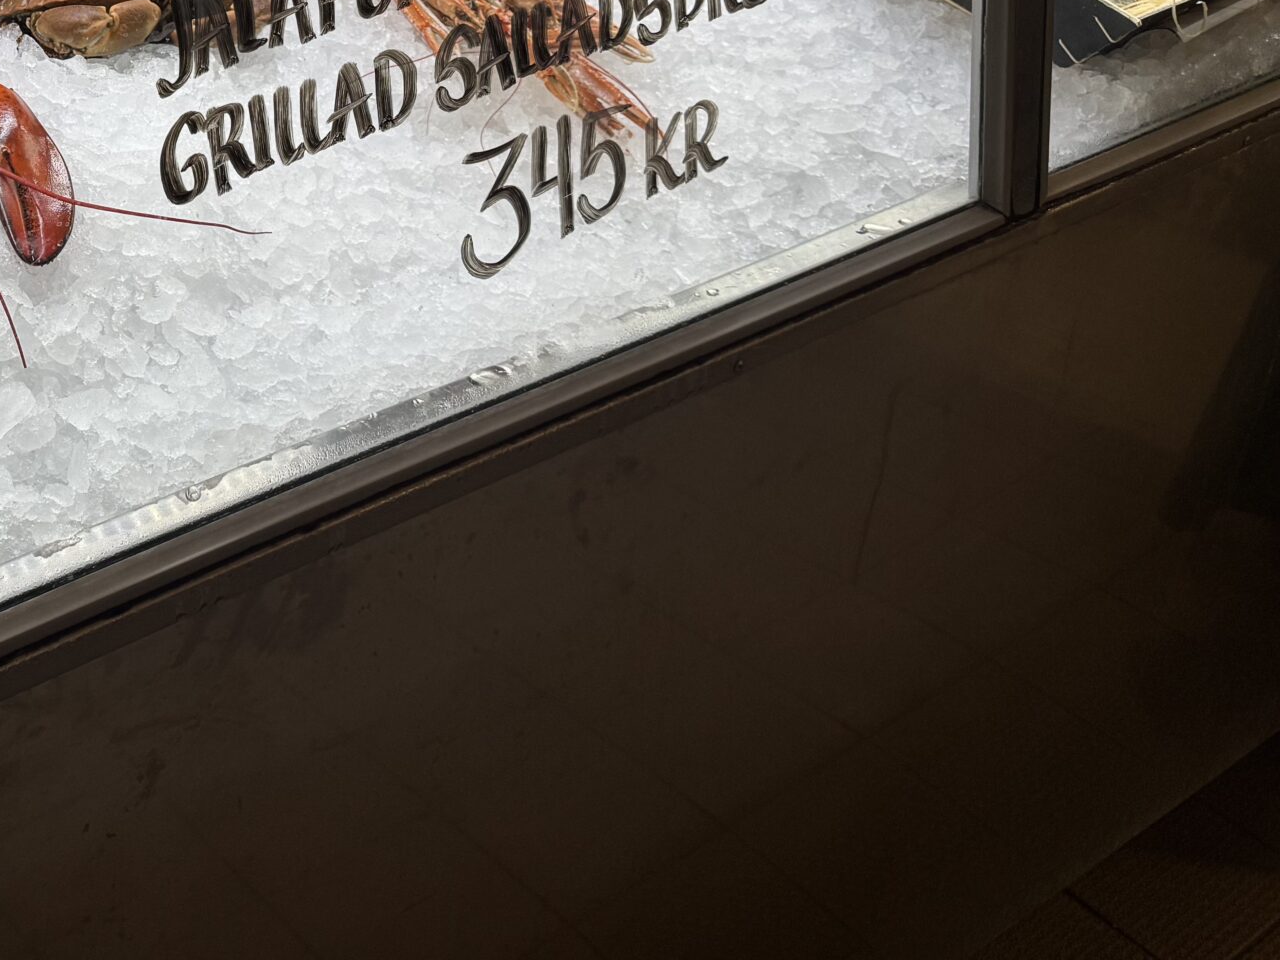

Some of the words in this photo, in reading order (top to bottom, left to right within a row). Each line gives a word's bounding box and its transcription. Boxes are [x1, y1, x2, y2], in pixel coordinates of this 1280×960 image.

[159, 49, 418, 205] GRILLAD
[461, 104, 632, 280] 345
[645, 99, 728, 200] KR
